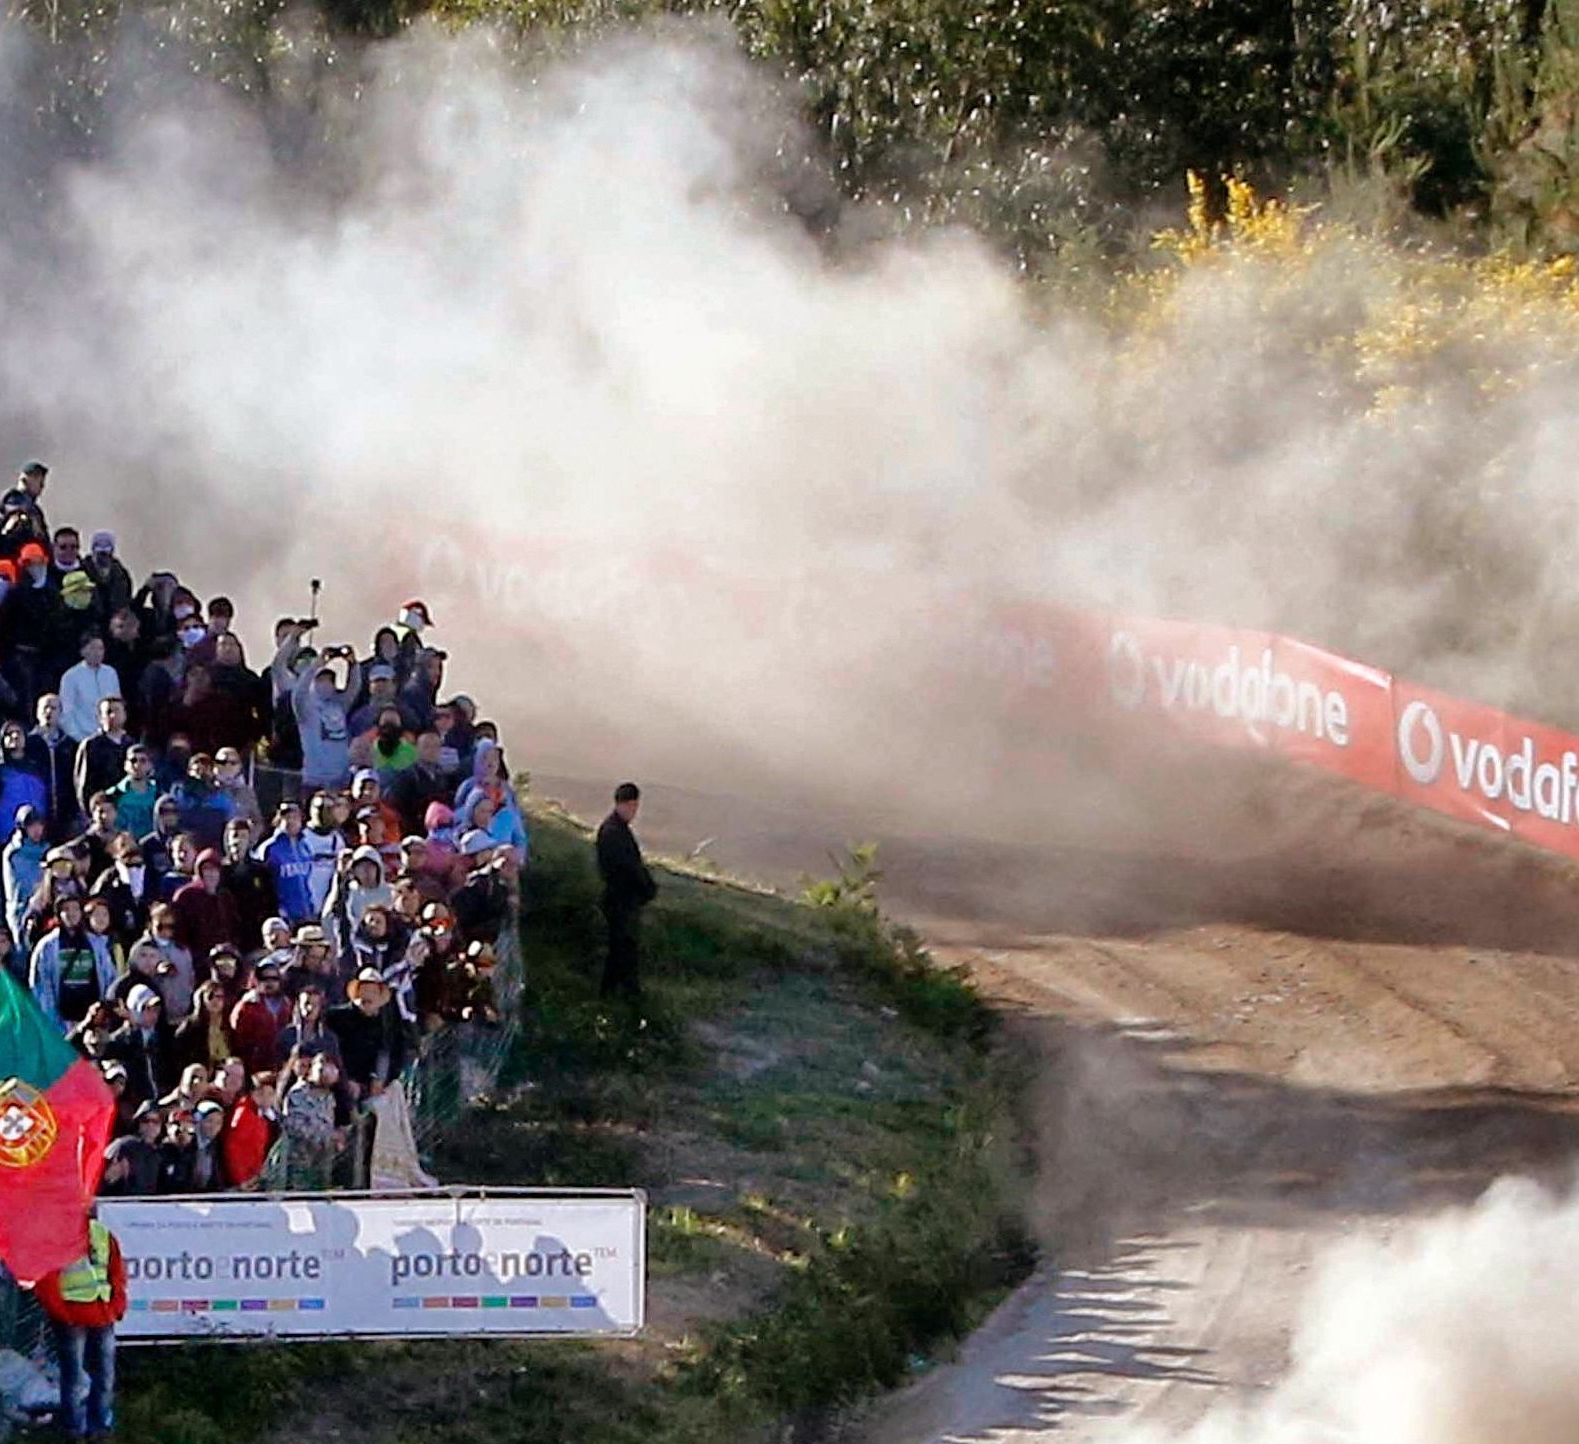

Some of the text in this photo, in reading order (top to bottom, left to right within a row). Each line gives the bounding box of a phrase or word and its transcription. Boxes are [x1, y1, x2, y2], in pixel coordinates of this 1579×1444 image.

[1449, 731, 1579, 825] vodaf
[232, 1250, 321, 1279] norte
[391, 1249, 481, 1286] porto
[501, 1249, 593, 1277] norte
